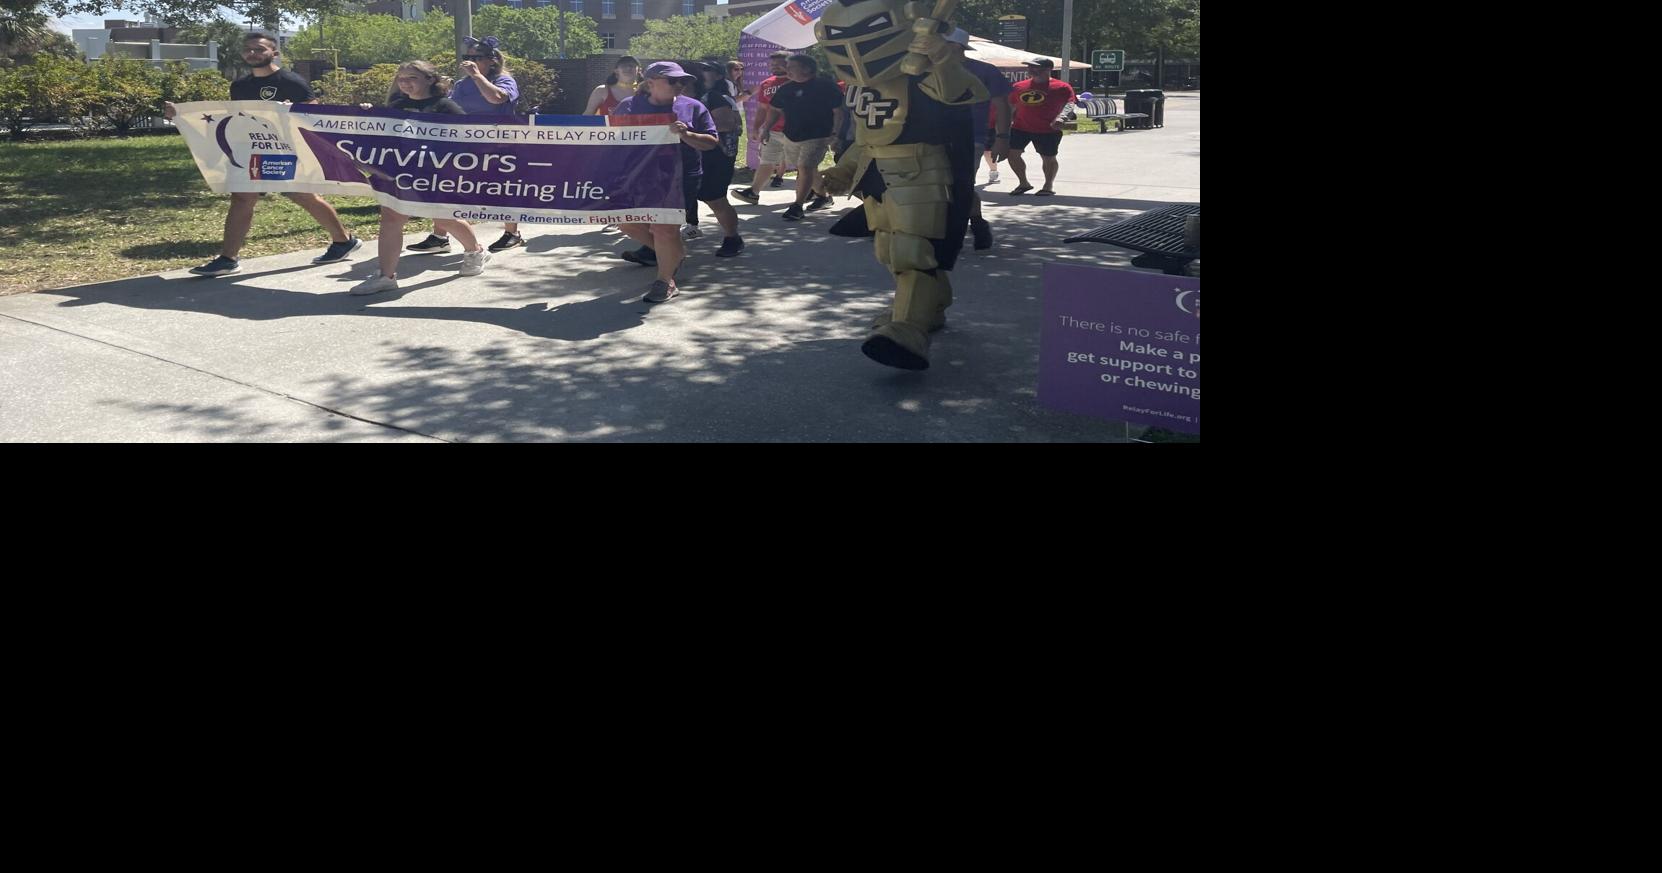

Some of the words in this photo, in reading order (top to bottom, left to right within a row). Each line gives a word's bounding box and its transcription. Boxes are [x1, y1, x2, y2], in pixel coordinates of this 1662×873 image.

[845, 85, 892, 126] UCF
[248, 132, 279, 141] RELAY
[313, 119, 386, 132] AMERICAN
[392, 124, 458, 138] CANCER
[465, 130, 530, 139] SOCIETY
[537, 131, 584, 140] RELAY
[589, 131, 616, 140] FOR
[622, 130, 647, 140] LIFE
[252, 142, 273, 150] FOR
[336, 139, 516, 173] Survivors
[395, 173, 556, 202] Celebrating
[563, 181, 610, 200] Life.
[453, 210, 515, 221] Celebrate.
[519, 214, 586, 224] Remember.
[589, 214, 624, 225] Fight
[1058, 315, 1105, 332] There
[1110, 322, 1122, 334] is
[1128, 327, 1150, 338] no
[1154, 330, 1190, 344] safe
[1119, 340, 1168, 358] Make
[1173, 351, 1184, 360] a
[1067, 351, 1095, 363] get
[1100, 356, 1173, 375] support
[1177, 367, 1197, 379] to
[1100, 374, 1120, 384] or
[1124, 376, 1200, 400] chewing
